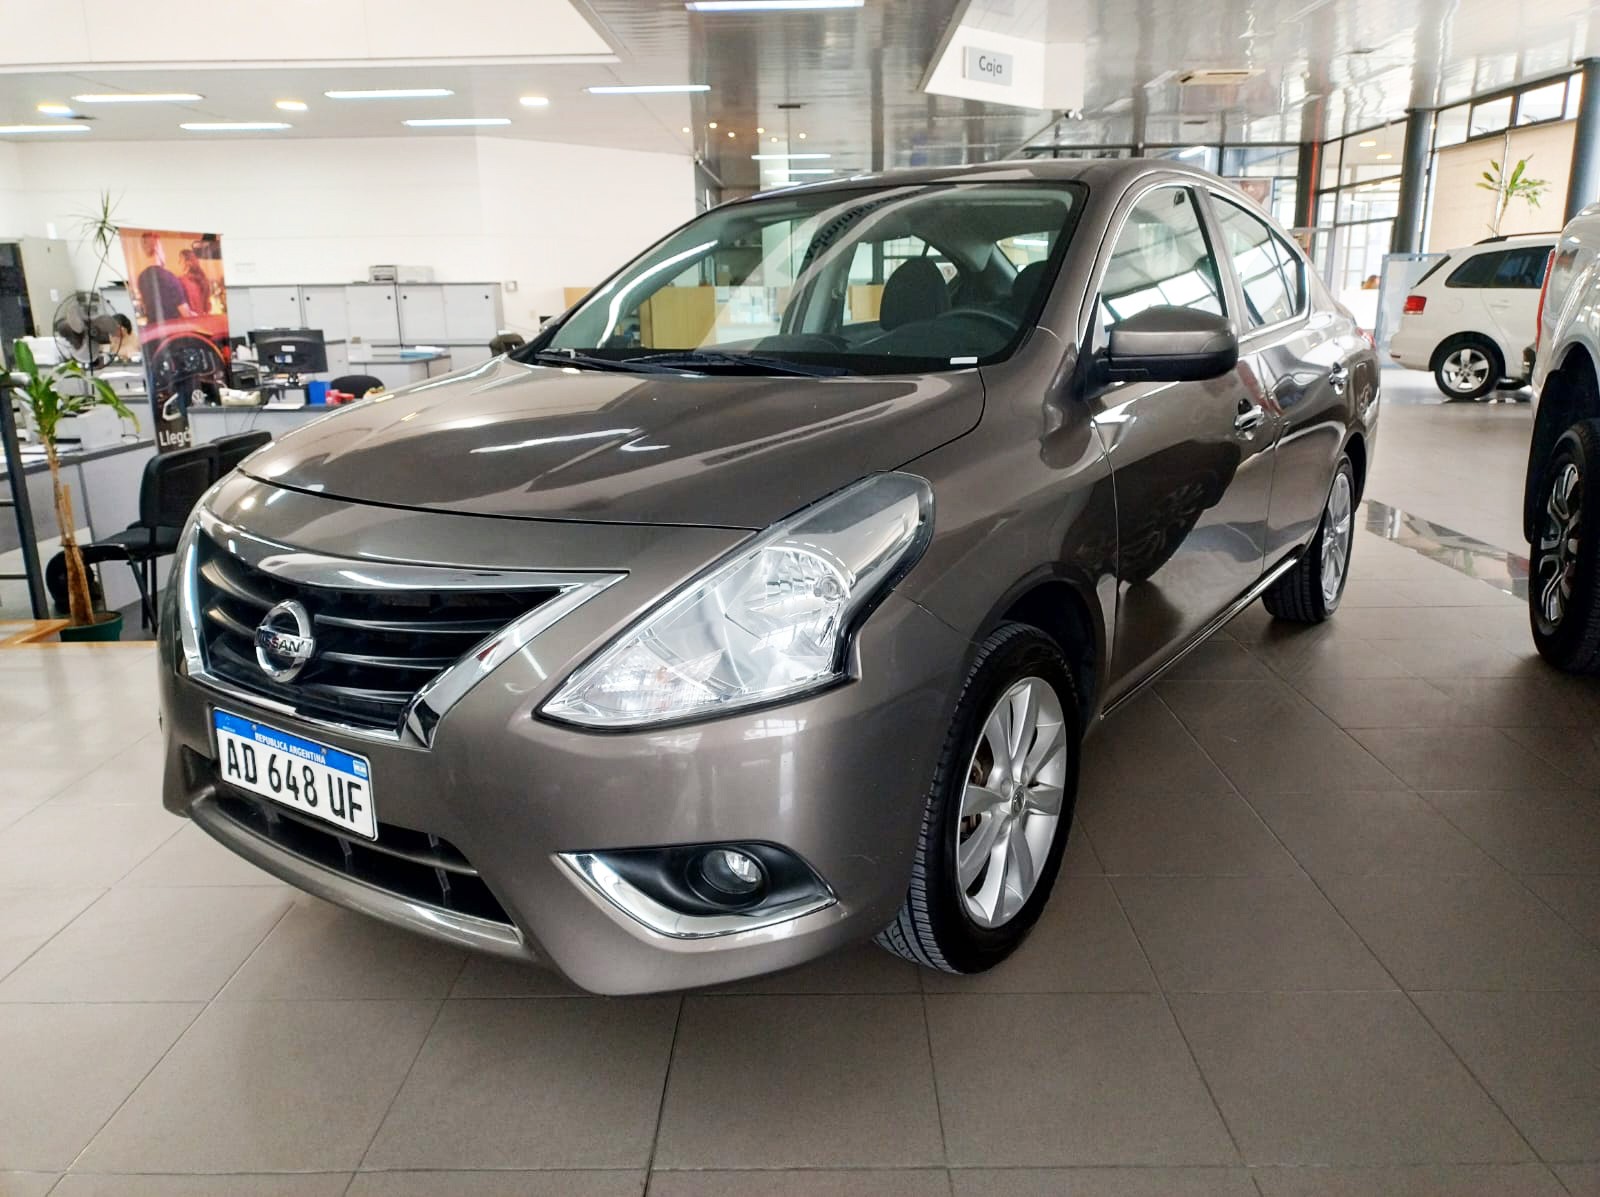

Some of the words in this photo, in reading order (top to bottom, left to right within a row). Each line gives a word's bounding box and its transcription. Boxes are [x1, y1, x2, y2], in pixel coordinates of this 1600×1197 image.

[979, 55, 1002, 77] Caja
[255, 732, 288, 753] REPUBLICA
[289, 745, 327, 765] ARGENTINA
[227, 738, 258, 785] AD
[268, 754, 318, 807] 648
[328, 773, 362, 823] UF
